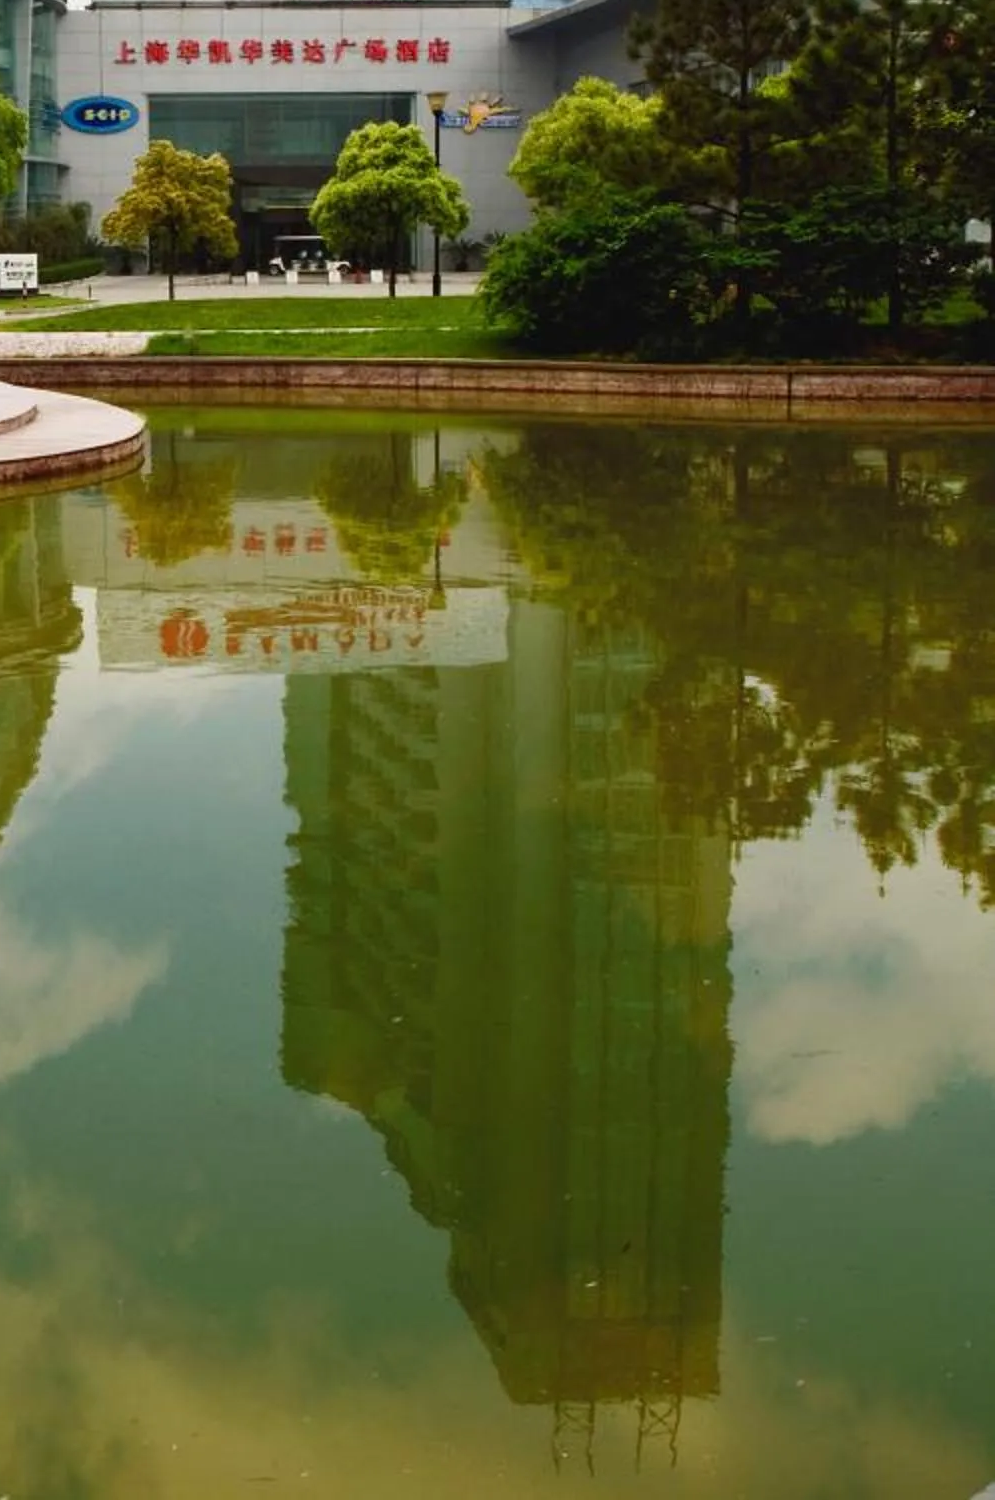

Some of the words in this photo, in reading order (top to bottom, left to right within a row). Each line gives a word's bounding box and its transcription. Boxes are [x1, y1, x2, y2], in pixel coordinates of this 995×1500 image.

[114, 39, 451, 64] 上海华凯华美达广场酒店
